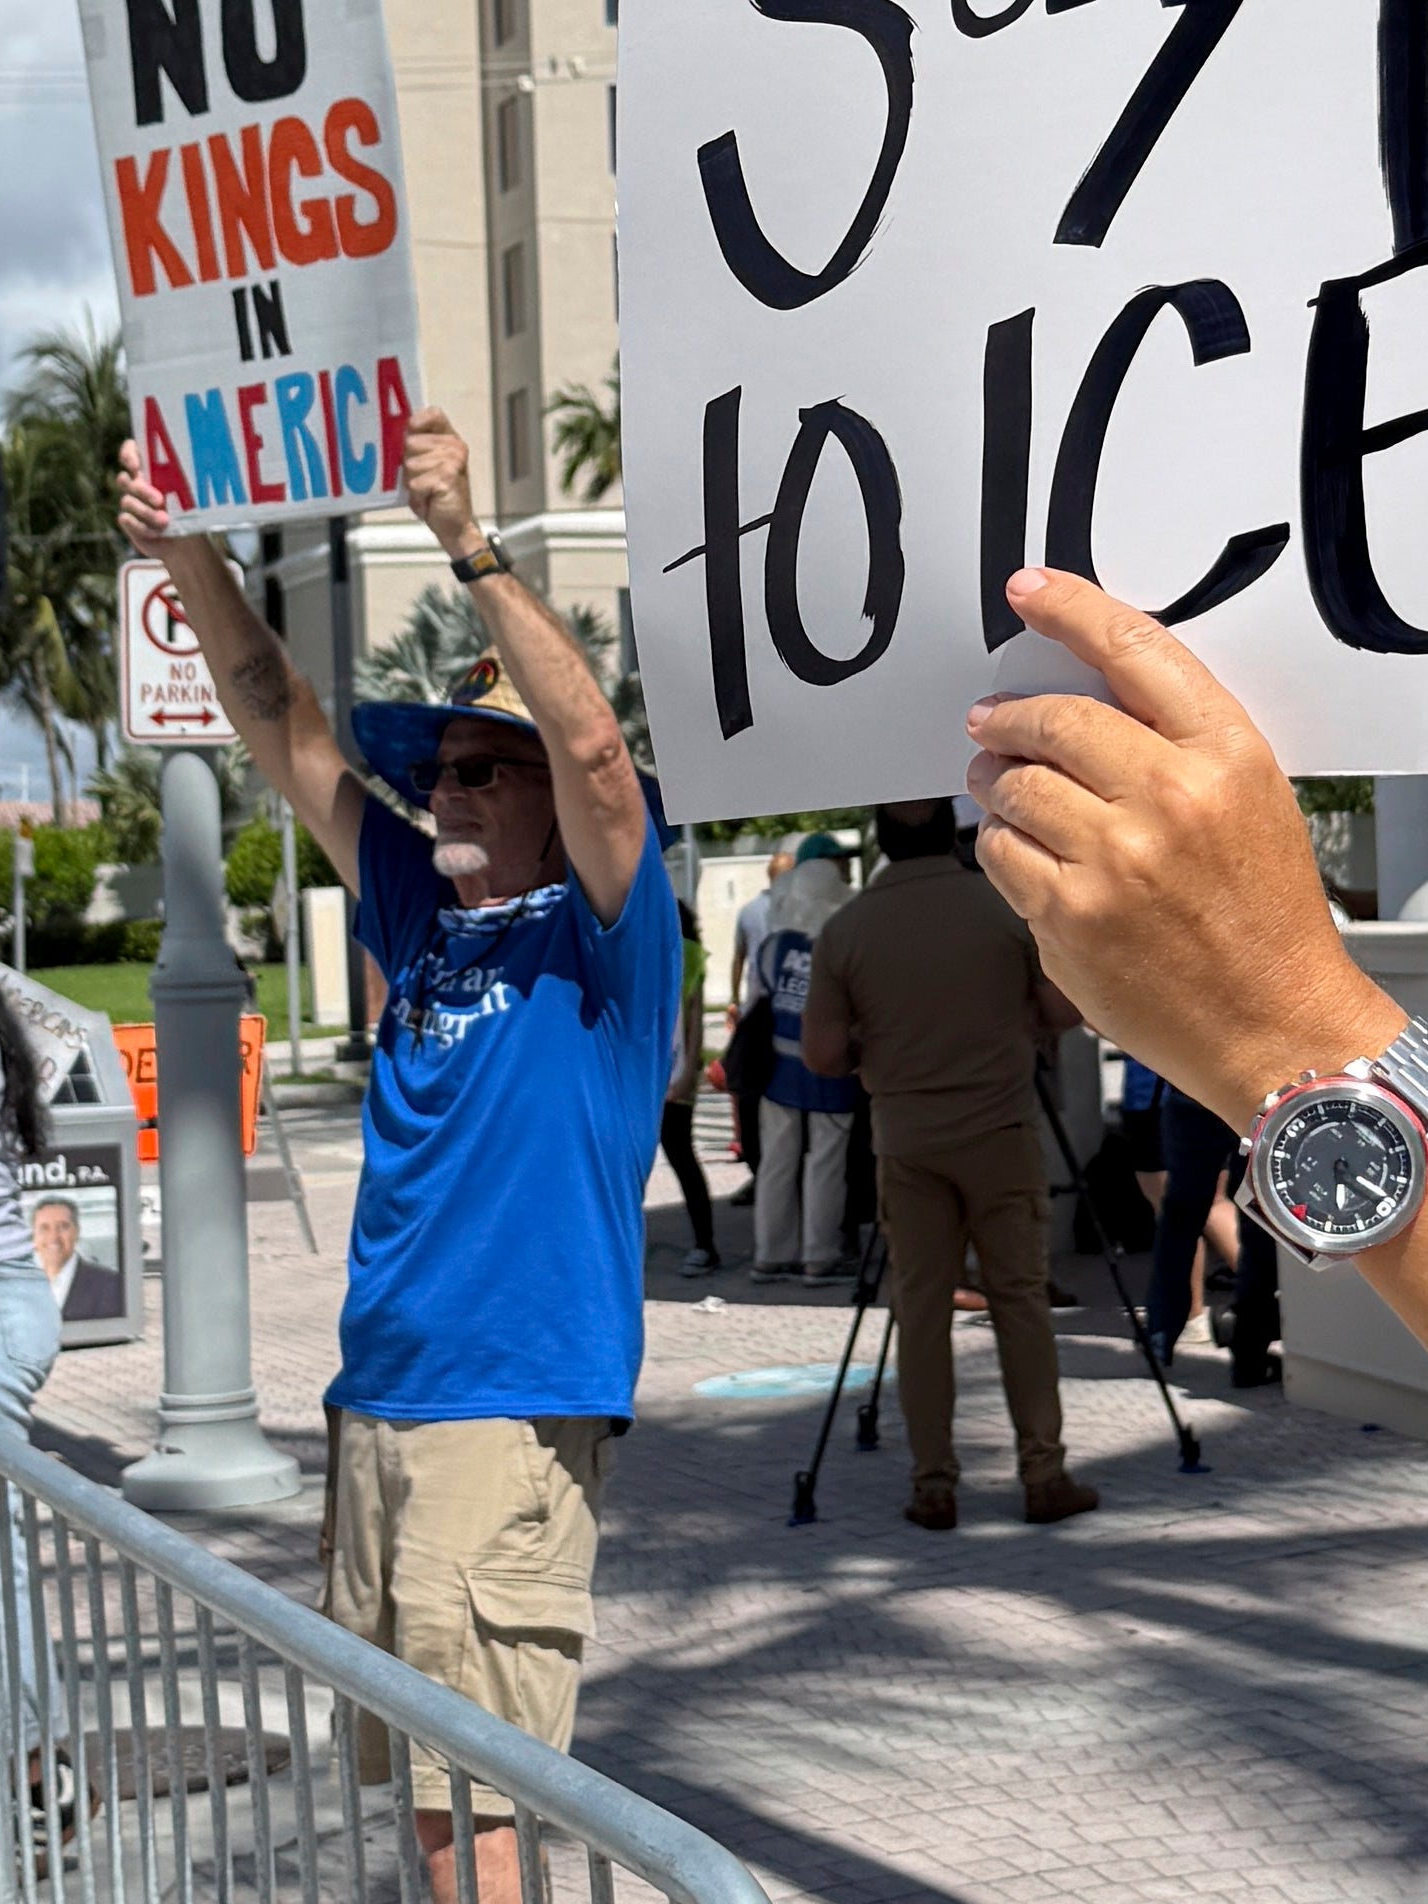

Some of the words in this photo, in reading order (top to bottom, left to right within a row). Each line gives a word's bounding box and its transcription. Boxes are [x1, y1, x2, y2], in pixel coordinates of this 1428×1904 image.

[115, 97, 399, 297] KINGS
[231, 279, 292, 362] IN
[143, 356, 414, 513] AMERICA
[140, 684, 215, 704] PARKIN
[170, 662, 197, 681] NO
